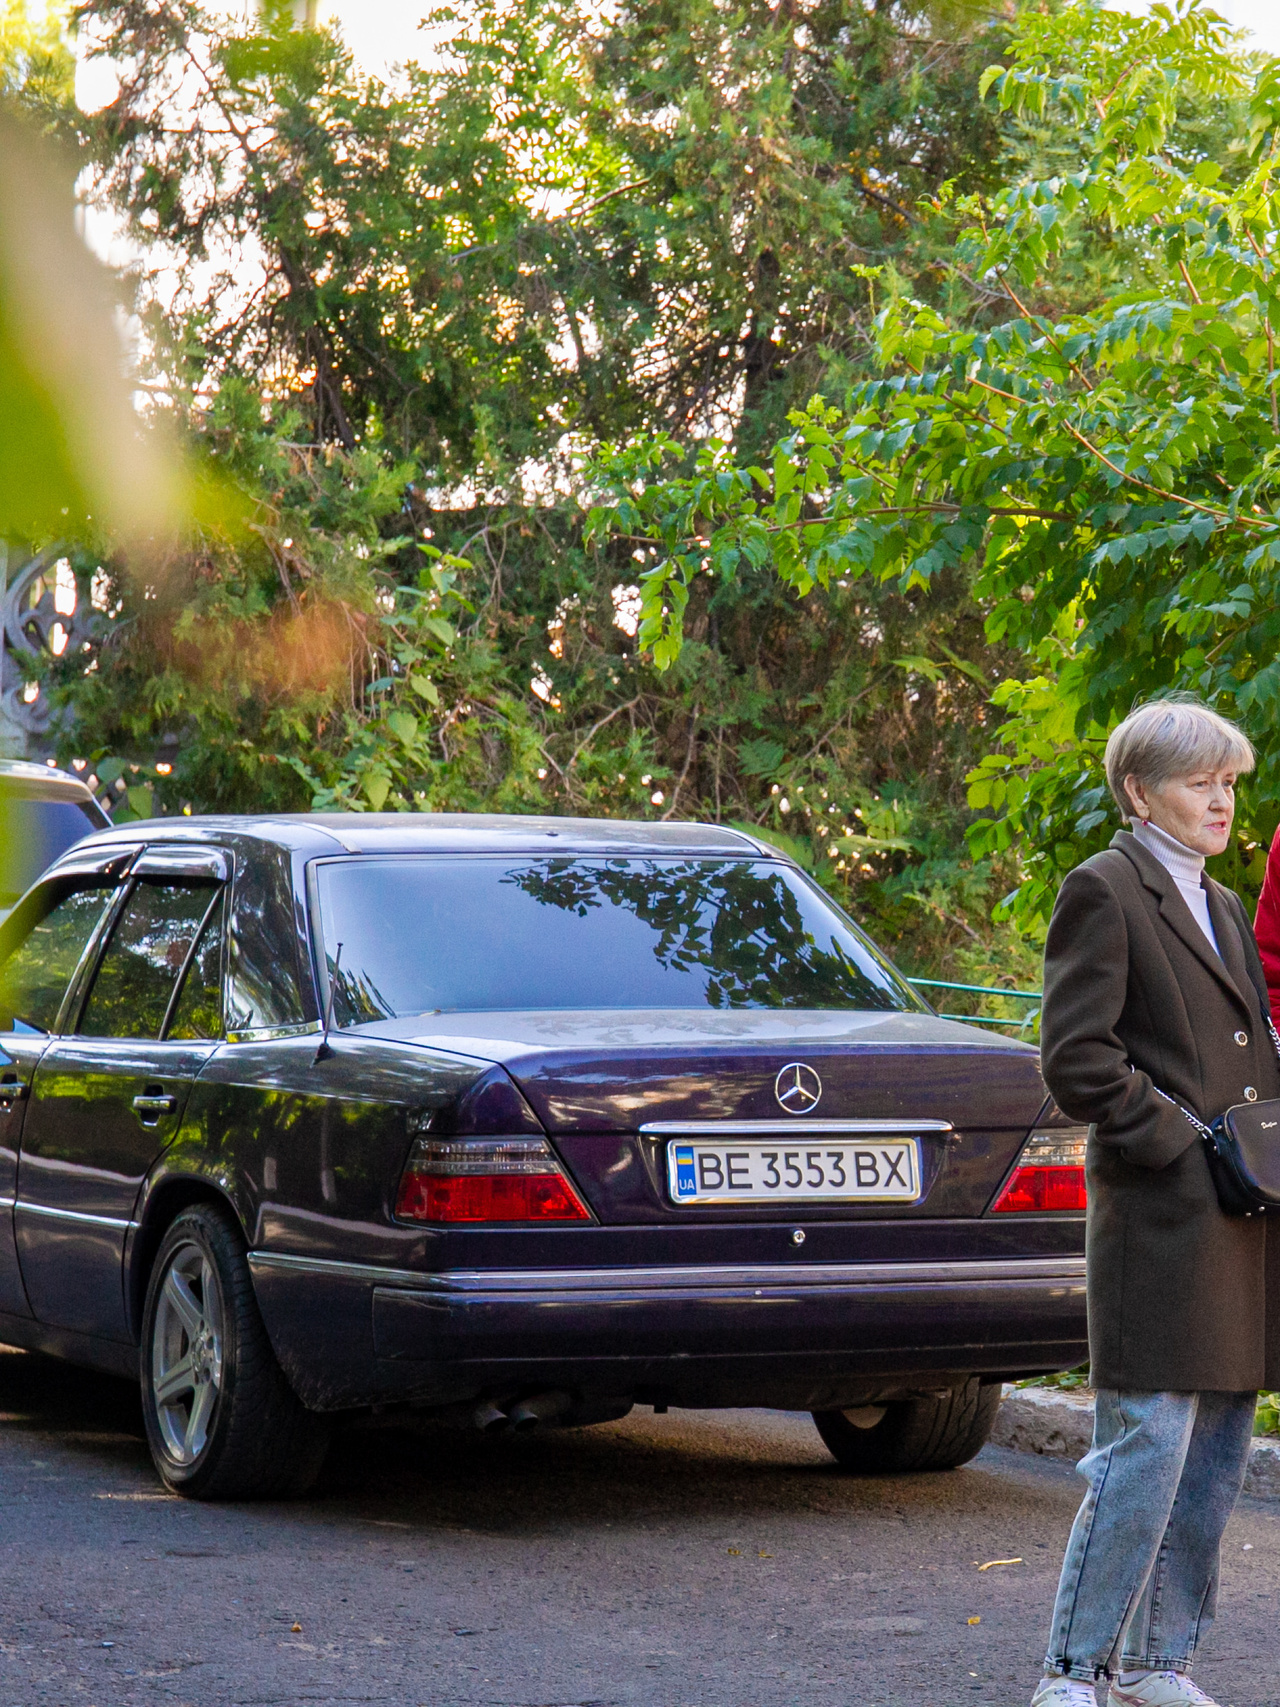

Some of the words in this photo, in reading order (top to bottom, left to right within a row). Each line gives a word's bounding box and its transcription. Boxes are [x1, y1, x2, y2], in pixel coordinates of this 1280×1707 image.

[698, 1152, 753, 1189] BE
[761, 1151, 846, 1188] 3553
[855, 1151, 907, 1188] BX
[679, 1179, 695, 1190] UA
